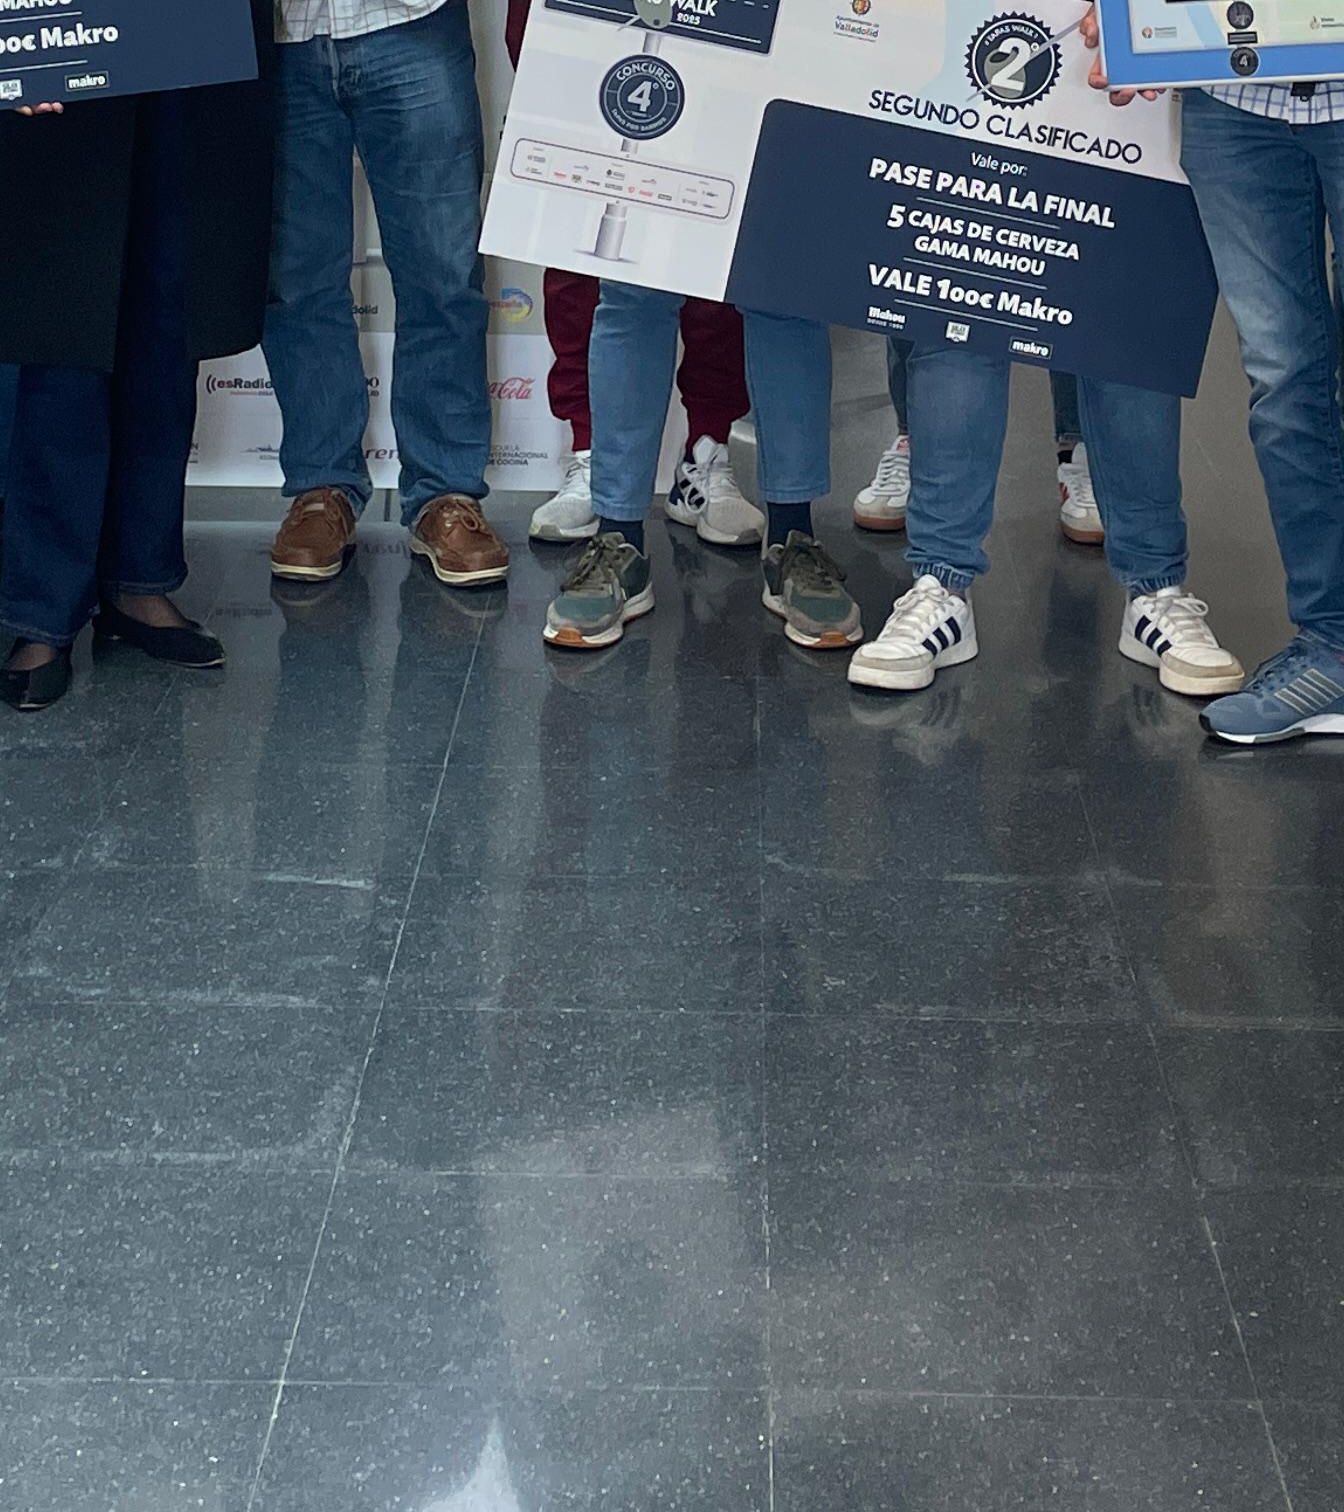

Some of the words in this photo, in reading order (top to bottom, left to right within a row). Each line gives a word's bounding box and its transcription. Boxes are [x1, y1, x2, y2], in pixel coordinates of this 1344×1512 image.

[676, 12, 700, 25] 2025
[835, 20, 879, 38] Valladolid
[40, 23, 119, 49] Makro
[68, 75, 106, 88] makro
[616, 63, 675, 90] CONCURSO
[869, 89, 980, 130] SEGUNDO
[986, 114, 1142, 164] CLASIFICADO
[971, 152, 998, 171] Vale
[1000, 161, 1028, 176] por:
[869, 158, 933, 189] PASE
[936, 172, 1003, 205] PARA
[1007, 187, 1038, 213] LA
[1043, 194, 1116, 228] FINAL
[887, 204, 906, 228] 5
[908, 210, 964, 235] CAJAS
[967, 221, 993, 241] DE
[995, 228, 1080, 260] CERVEZA
[914, 236, 970, 261] GAMA
[973, 247, 1046, 276] MAHOU
[869, 264, 933, 296] VALE
[936, 278, 994, 309] 100€
[997, 291, 1073, 326] Makro
[868, 306, 906, 324] Mahou
[1012, 340, 1049, 356] makro
